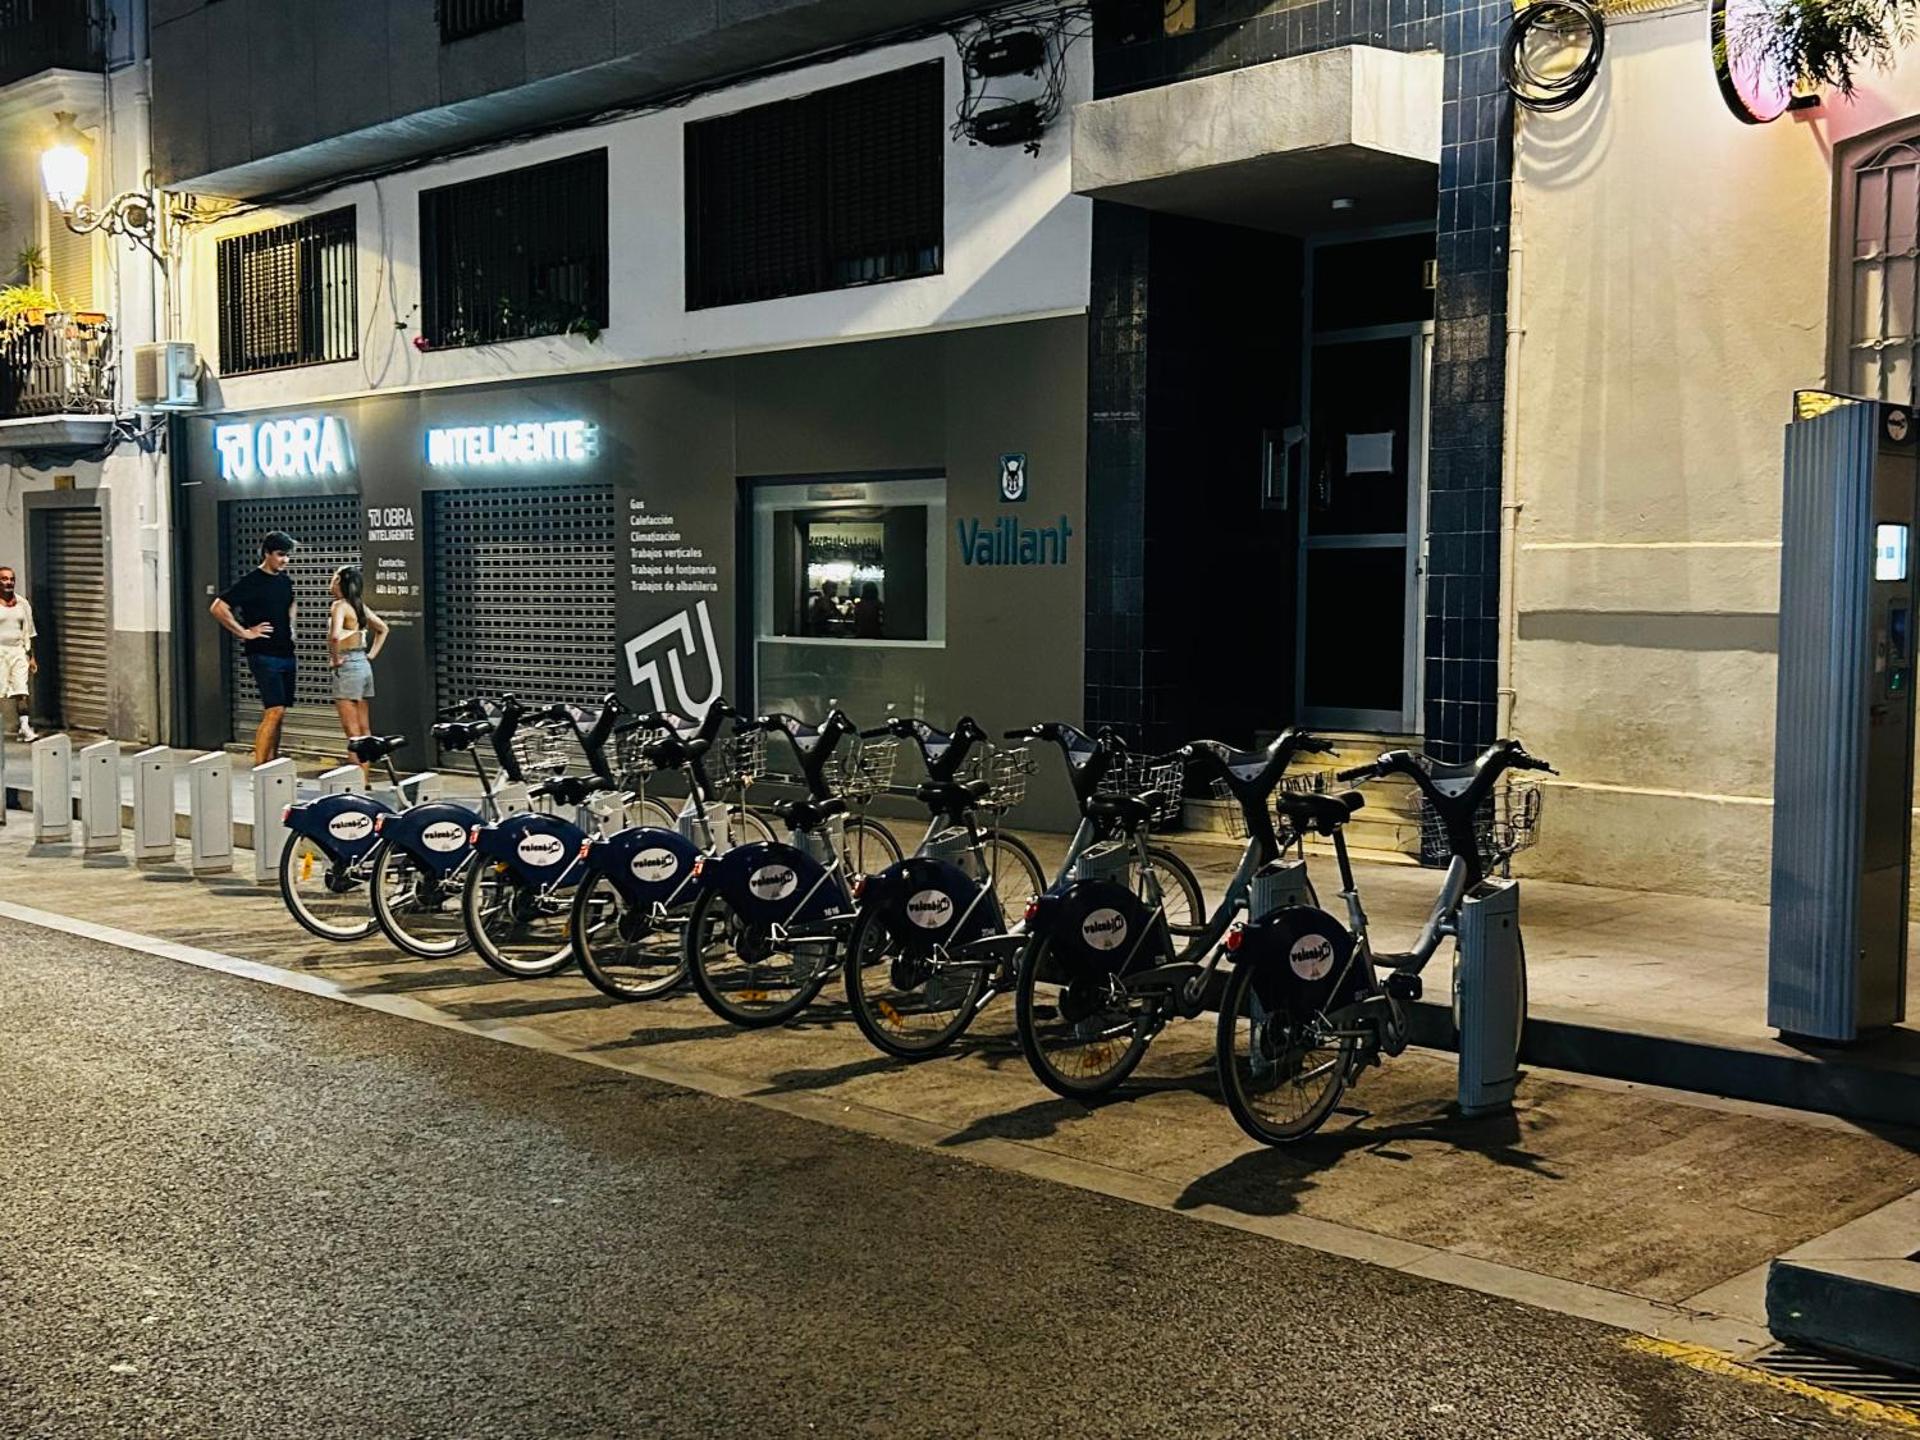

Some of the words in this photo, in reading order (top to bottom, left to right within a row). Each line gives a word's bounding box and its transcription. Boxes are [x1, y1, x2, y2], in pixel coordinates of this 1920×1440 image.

[214, 423, 253, 480] TU
[257, 415, 344, 478] OBRA
[427, 419, 592, 466] INTELIGENTE
[367, 509, 381, 527] TU
[383, 507, 414, 527] OBRA
[368, 529, 415, 541] INTELIGENTE
[957, 514, 1072, 566] Vaillant
[630, 548, 663, 561] Trabajos
[664, 547, 703, 558] verticales
[630, 564, 663, 577] Trabajos
[664, 564, 674, 574] de
[630, 580, 663, 593] Trabajos
[664, 580, 675, 591] de
